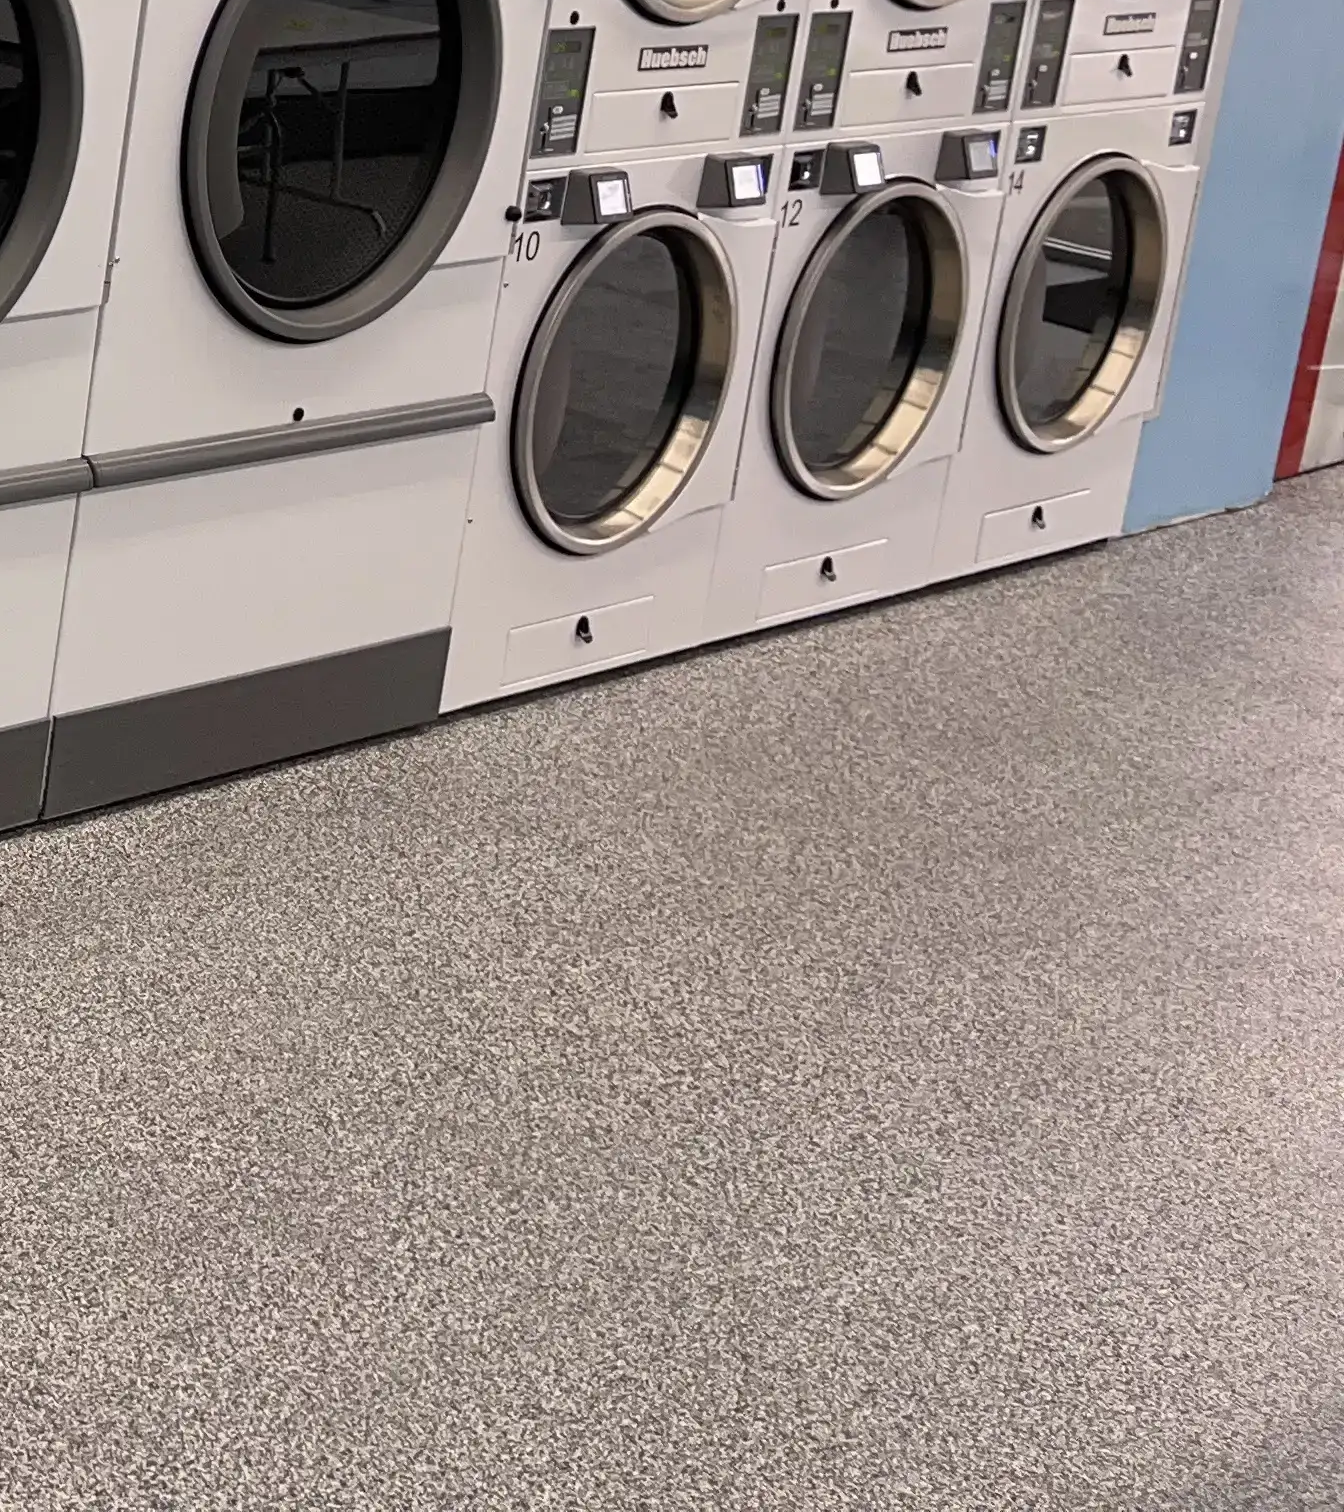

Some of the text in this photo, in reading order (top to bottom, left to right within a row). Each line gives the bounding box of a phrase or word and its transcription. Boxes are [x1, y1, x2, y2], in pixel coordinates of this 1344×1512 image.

[640, 46, 707, 69] Huebsch
[1008, 169, 1025, 196] 14
[781, 198, 803, 228] 12
[514, 230, 541, 263] 10
